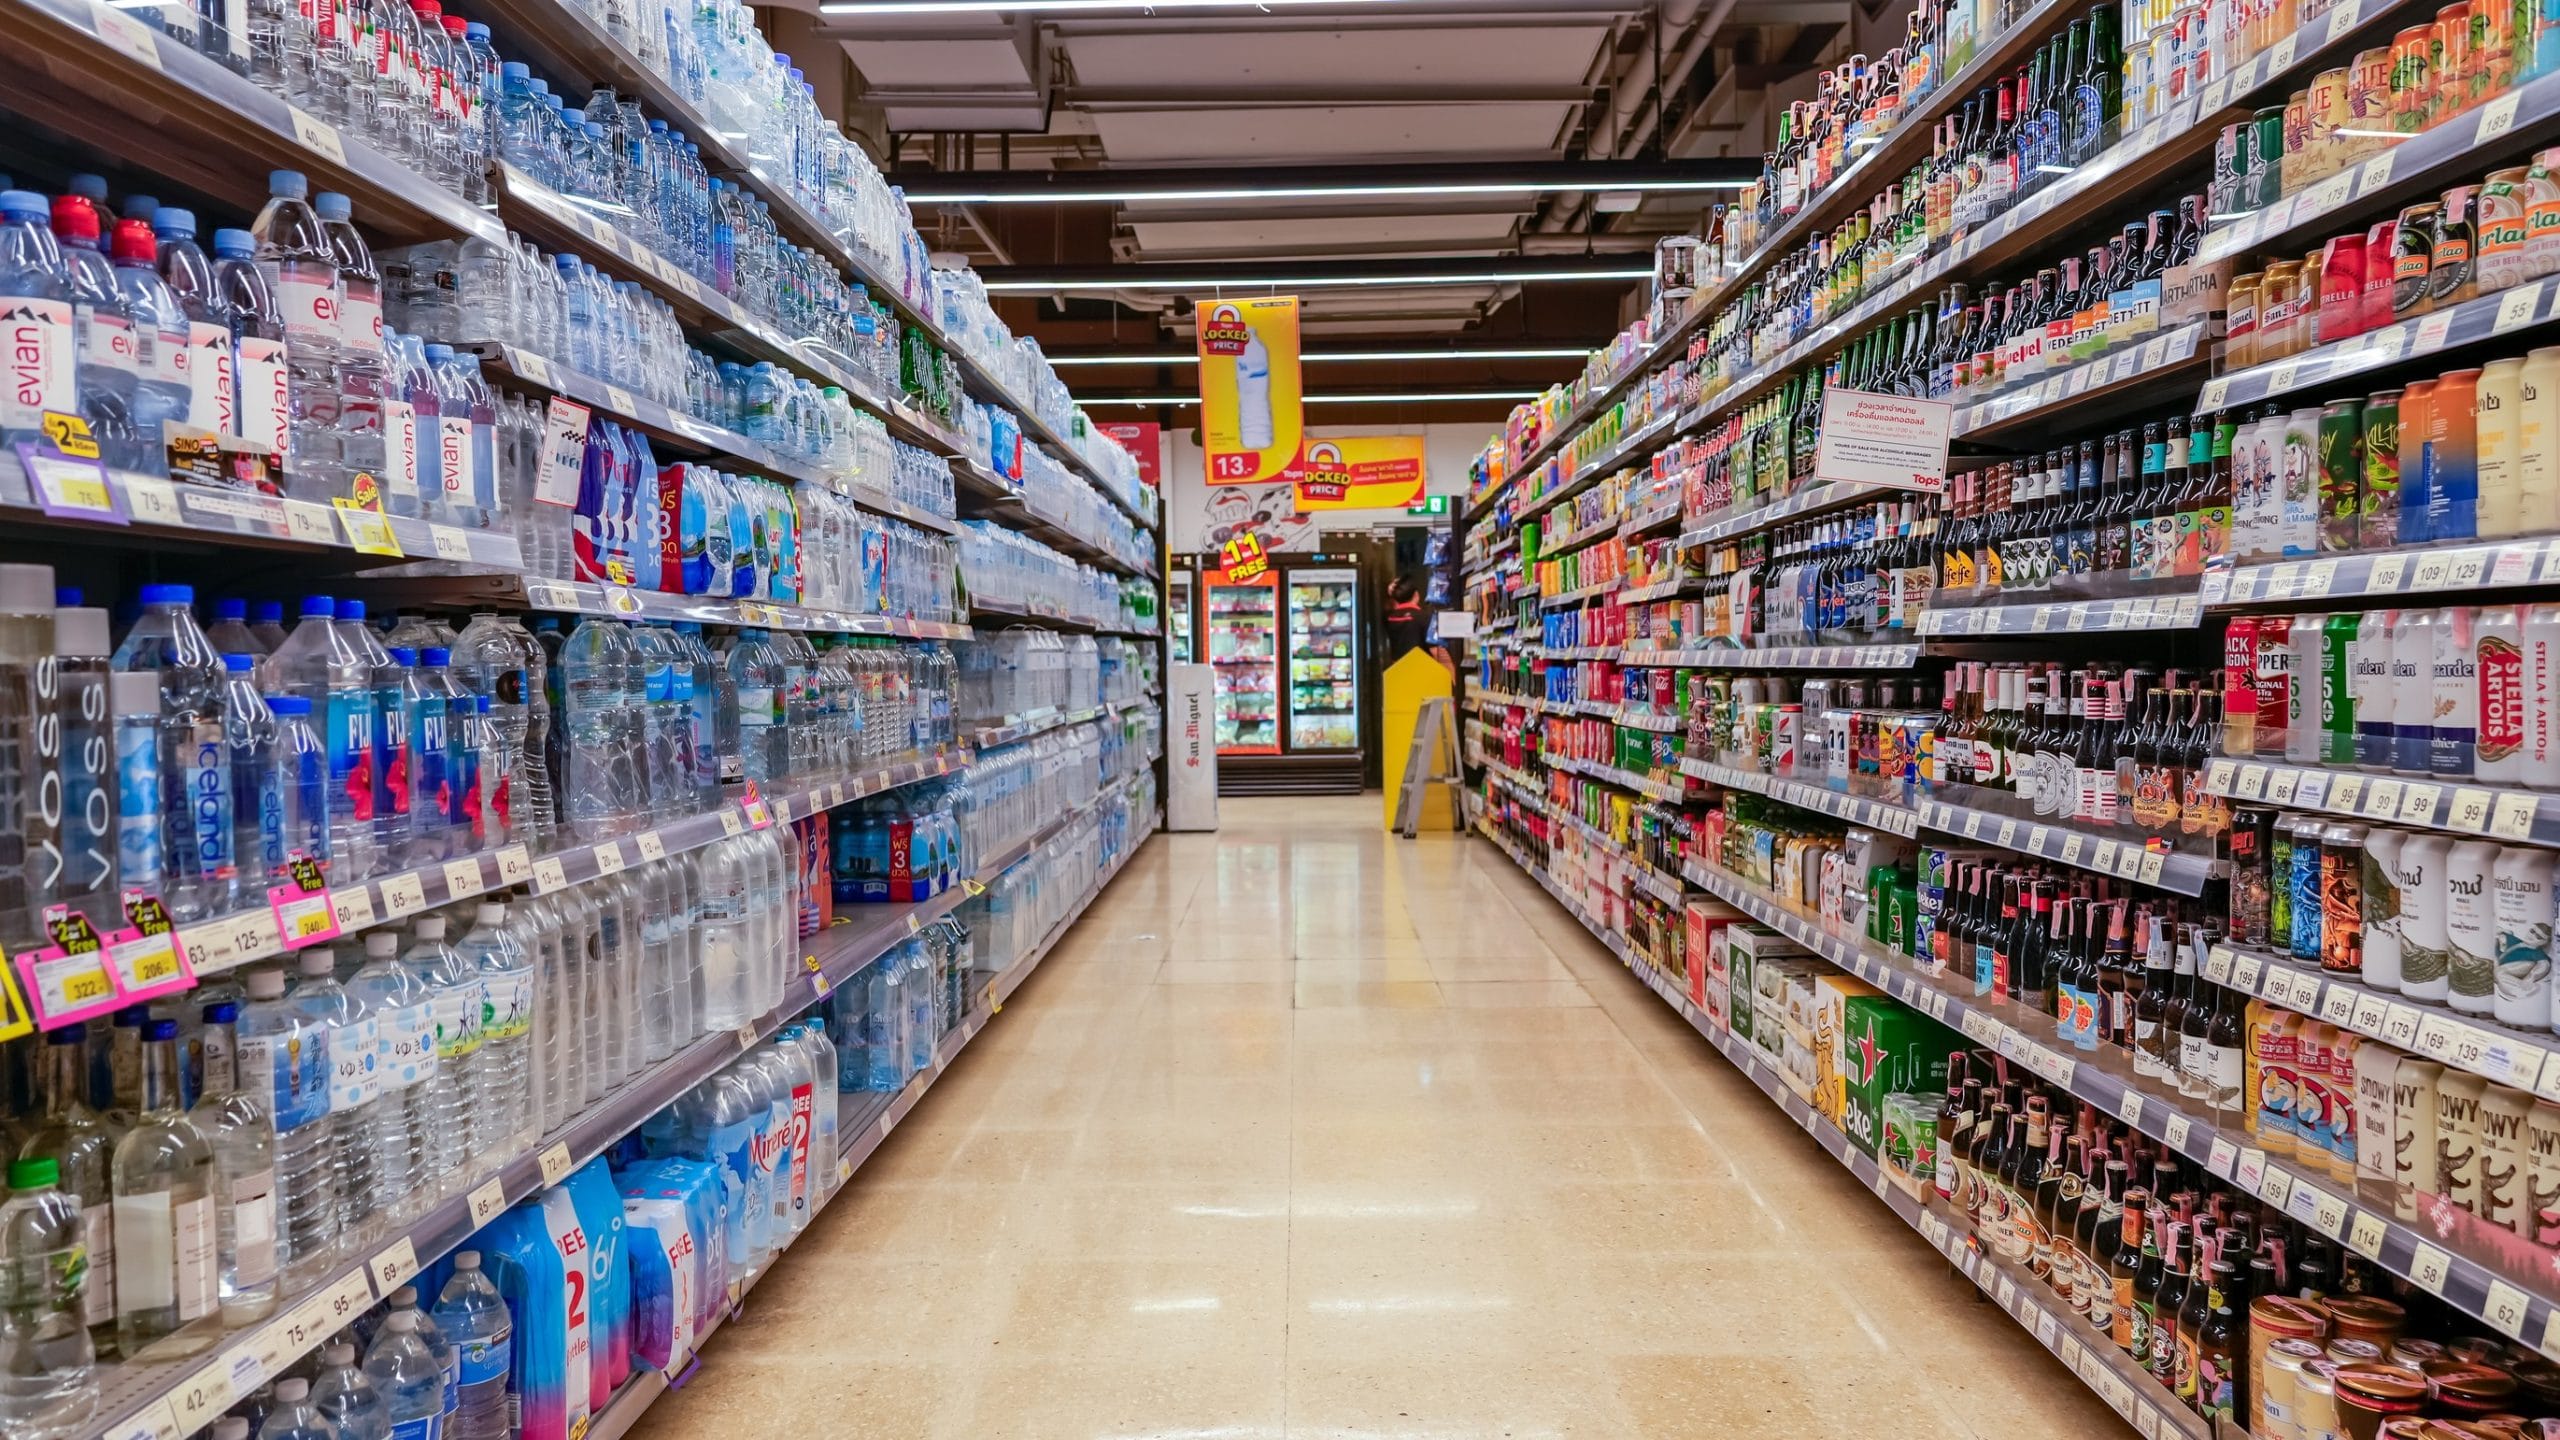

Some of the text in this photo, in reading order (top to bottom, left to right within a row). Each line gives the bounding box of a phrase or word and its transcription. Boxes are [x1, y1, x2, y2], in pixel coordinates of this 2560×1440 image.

[2336, 14, 2350, 29] 59
[2235, 76, 2250, 92] 149
[2486, 115, 2508, 133] 189
[2367, 171, 2385, 187] 189
[2189, 274, 2218, 295] RTHA
[2510, 303, 2526, 320] 55
[1203, 329, 1249, 341] LOCKED
[1214, 342, 1238, 350] PRICE
[15, 325, 42, 408] evian
[271, 369, 288, 451] evian
[174, 437, 200, 452] SINO
[401, 423, 414, 481] evian
[443, 434, 461, 492] evian
[1283, 469, 1303, 479] Tops
[1305, 471, 1351, 484] OCKED
[1912, 474, 1940, 487] Tops
[357, 483, 378, 508] Sale
[1309, 485, 1339, 496] PRICE
[1228, 558, 1267, 583] FREE
[2377, 571, 2395, 586] 109
[2421, 567, 2440, 582] 109
[2456, 564, 2477, 580] 129
[2487, 661, 2503, 738] ARTOIS
[2505, 661, 2522, 738] STELLA
[2534, 641, 2547, 763] STELLA ARTOIS
[348, 714, 372, 750] FIJ
[386, 711, 406, 745] FIJ
[424, 717, 446, 750] FIJ
[1186, 693, 1201, 767] San Miguel
[37, 655, 62, 890] VOSS
[82, 683, 110, 891] VOSS
[2340, 788, 2353, 804] 99
[2376, 795, 2391, 810] 99
[2413, 796, 2428, 813] 99
[2464, 804, 2480, 821] 99
[2512, 809, 2529, 827] 79
[507, 860, 519, 875] 43
[894, 850, 906, 869] 3
[302, 877, 323, 891] Free
[455, 875, 467, 891] 73
[392, 891, 406, 909] 85
[337, 906, 351, 923] 60
[144, 919, 171, 937] Free
[69, 938, 99, 955] Free
[235, 931, 259, 953] 125
[189, 945, 207, 966] 63
[143, 961, 164, 980] 206
[2210, 961, 2224, 977] 185
[2239, 970, 2253, 986] 199
[74, 980, 97, 999] 322
[2269, 981, 2285, 997] 199
[2295, 988, 2311, 1005] 169
[2330, 1001, 2347, 1017] 189
[2360, 1011, 2378, 1028] 199
[2391, 1022, 2409, 1039] 179
[2425, 1032, 2444, 1049] 169
[2458, 1042, 2478, 1061] 139
[2125, 1103, 2137, 1117] 129
[793, 1115, 810, 1156] 2
[2169, 1127, 2183, 1142] 119
[2265, 1183, 2282, 1199] 159
[478, 1202, 490, 1217] 85
[2318, 1208, 2336, 1227] 159
[2357, 1229, 2376, 1248] 114
[384, 1263, 397, 1282] 69
[2423, 1265, 2438, 1283] 58
[334, 1296, 350, 1316] 95
[565, 1269, 586, 1331] 2
[2498, 1306, 2515, 1324] 62
[287, 1325, 305, 1346] 75
[185, 1390, 206, 1413] 42
